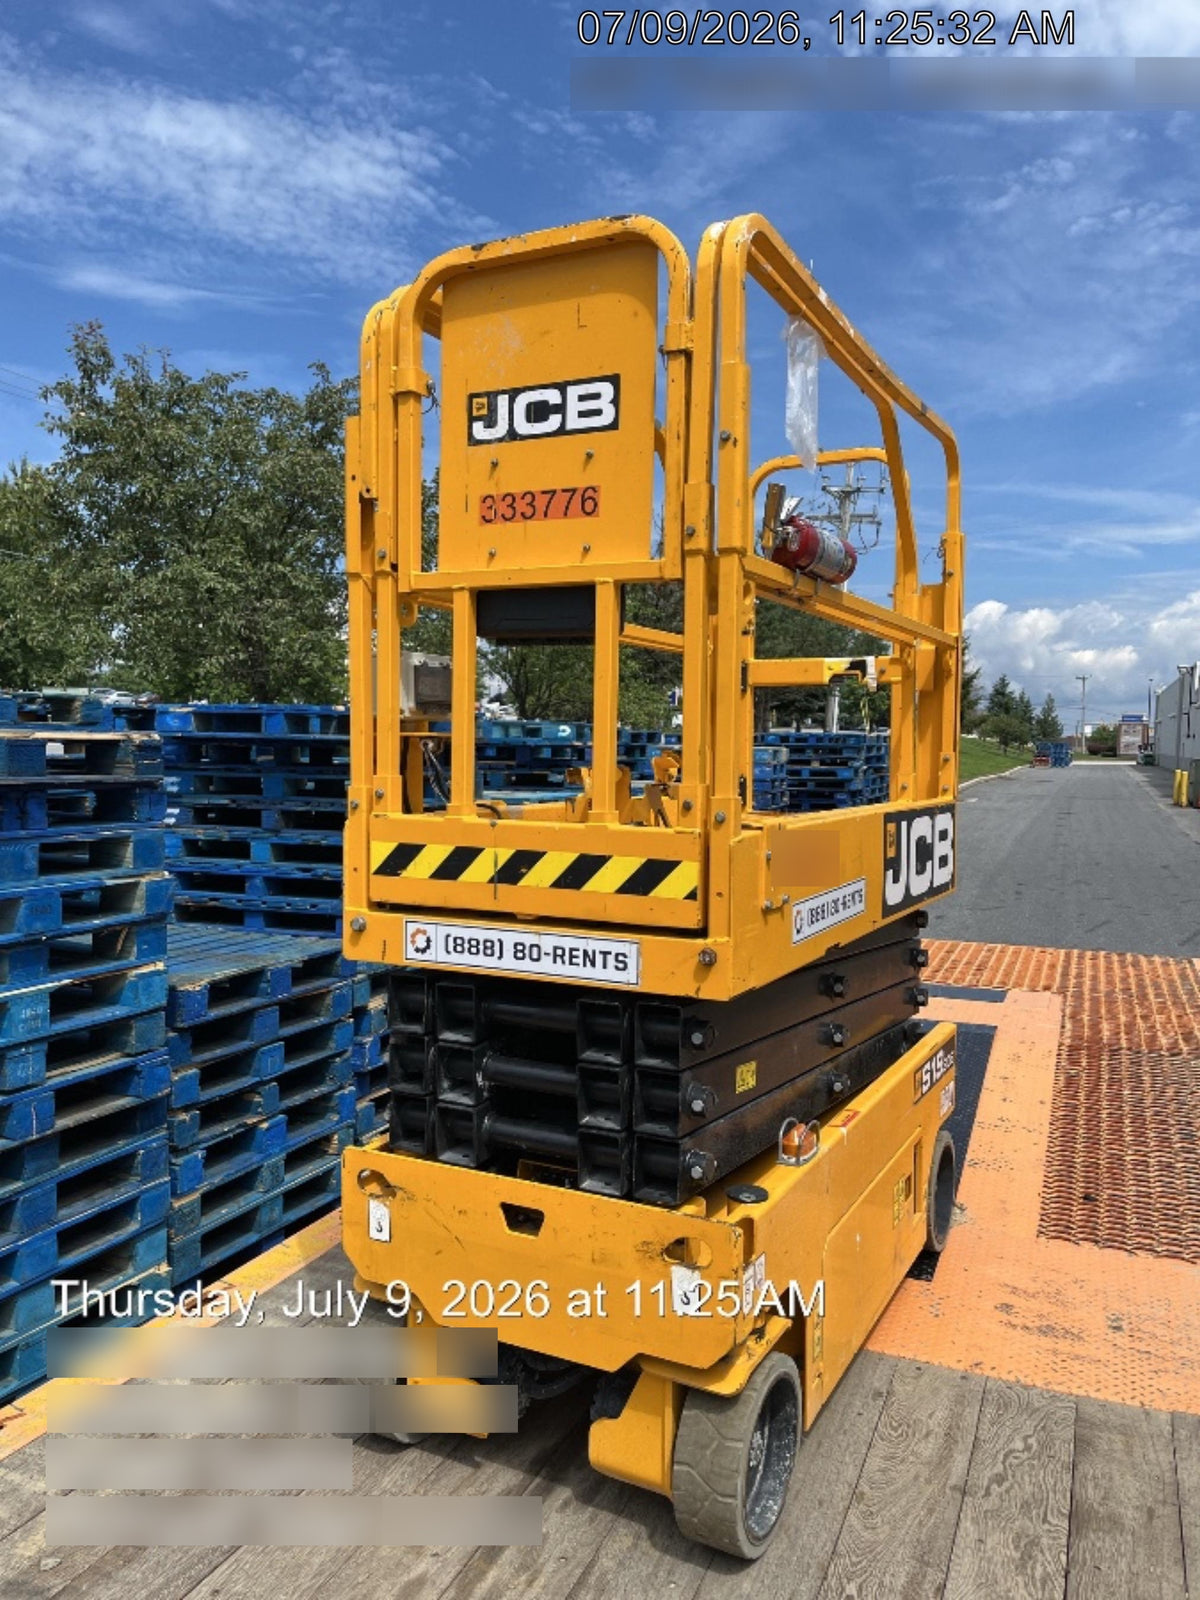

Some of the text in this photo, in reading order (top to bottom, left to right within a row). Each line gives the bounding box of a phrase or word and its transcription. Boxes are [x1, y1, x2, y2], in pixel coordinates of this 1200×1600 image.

[471, 381, 617, 441] JCB
[480, 485, 599, 524] 333776
[885, 812, 954, 905] JCB
[444, 933, 629, 972] (888) 80-RENTS
